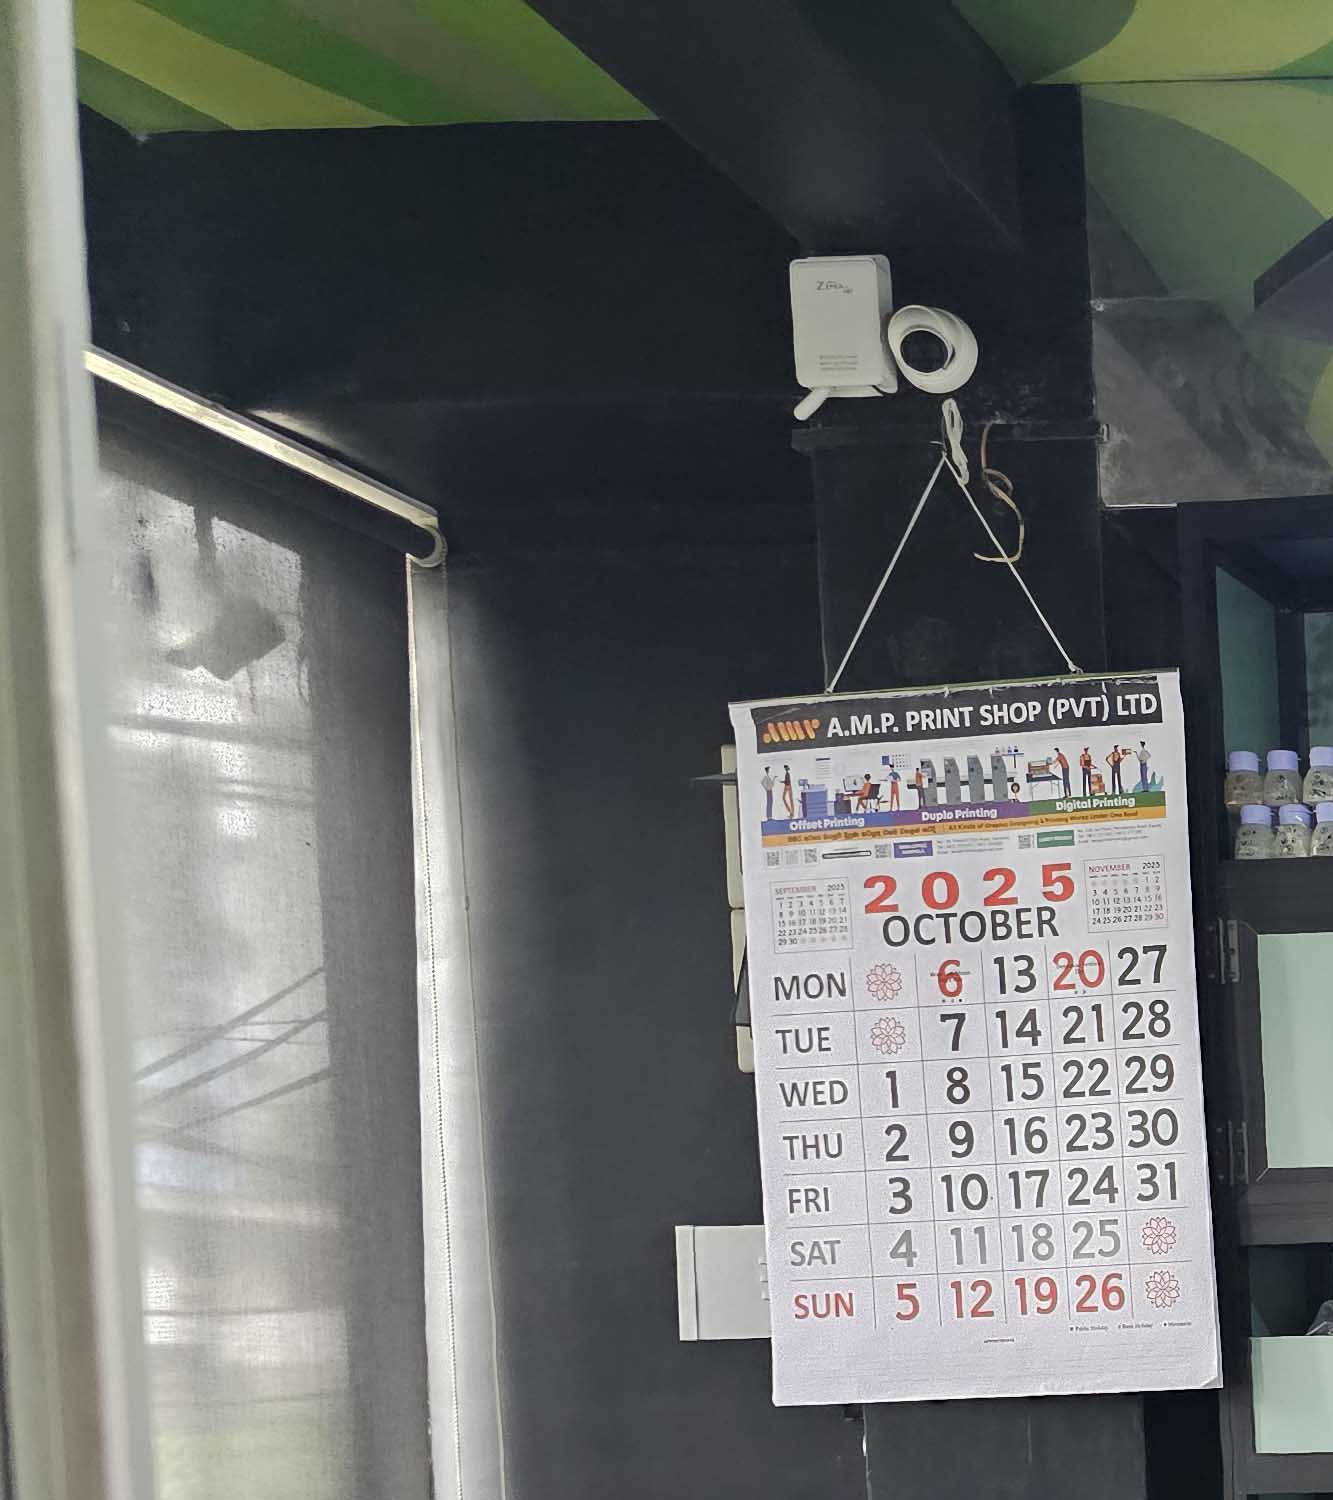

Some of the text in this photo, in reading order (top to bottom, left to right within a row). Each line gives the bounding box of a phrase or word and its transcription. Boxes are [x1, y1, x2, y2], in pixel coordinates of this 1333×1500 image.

[827, 712, 899, 738] A.M.P.
[905, 706, 973, 732] PRINT
[980, 701, 1041, 726] SHOP
[1048, 695, 1109, 724] (PVT)
[1117, 693, 1157, 716] LTD
[789, 816, 865, 832] Offset Printing
[921, 807, 997, 823] Duplo Printing
[1055, 796, 1136, 811] Digital Printing
[1089, 864, 1130, 872] NOVEMBER
[882, 906, 1059, 947] OCTOBER
[774, 944, 1169, 1001] MON 6 13 20 27
[776, 999, 1172, 1054] TUE 7 14 21 28
[780, 1053, 1175, 1108] WED 1 8 15 22 29
[783, 1107, 1179, 1162] THU 2 9 16 23 30
[788, 1161, 1178, 1215] FRI 3 10 17 24 31
[790, 1219, 1121, 1268] SAT 4 11 18 25
[794, 1273, 1125, 1321] SUN 5 12 19 26
